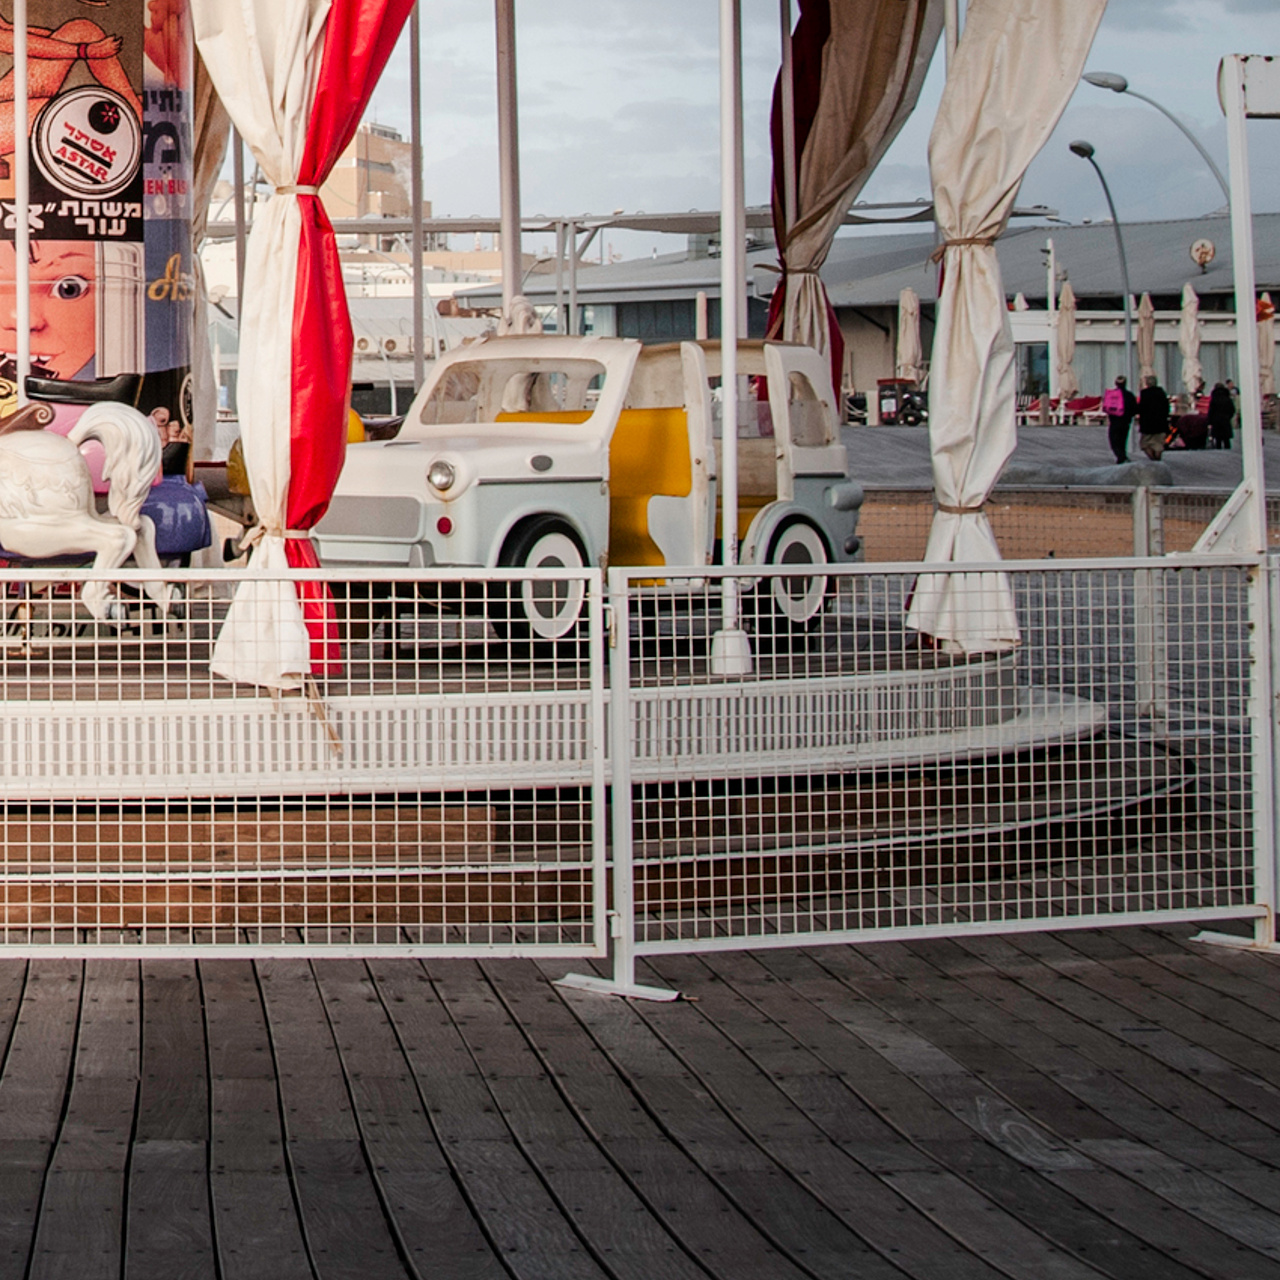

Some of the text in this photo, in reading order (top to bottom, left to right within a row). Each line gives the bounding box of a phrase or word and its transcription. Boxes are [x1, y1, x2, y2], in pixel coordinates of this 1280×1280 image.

[64, 121, 117, 162] אסתר
[55, 146, 109, 182] ASTAR
[58, 200, 141, 218] משחת
[74, 218, 127, 236] עור
